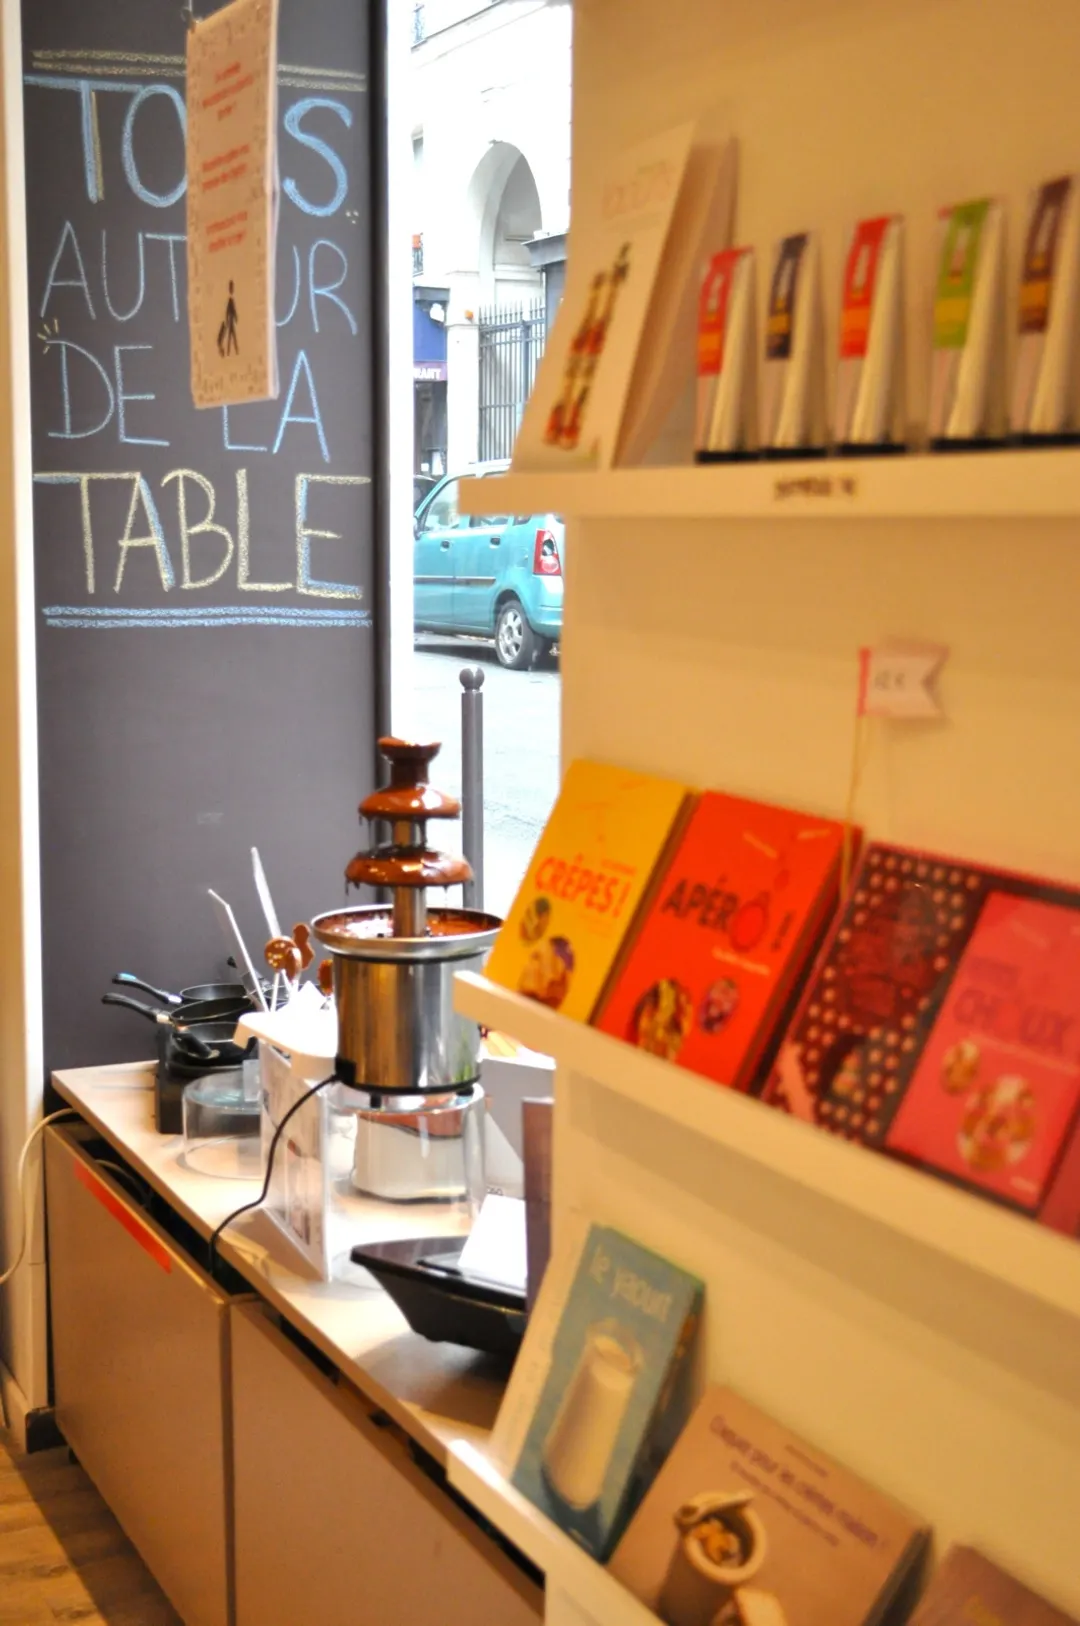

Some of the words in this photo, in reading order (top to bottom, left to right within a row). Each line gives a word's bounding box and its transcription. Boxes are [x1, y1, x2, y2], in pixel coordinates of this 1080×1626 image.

[24, 74, 353, 217] TOS
[40, 221, 357, 335] AUTUR
[45, 340, 170, 447] DE
[222, 350, 330, 463] LA
[33, 468, 371, 599] TABLE
